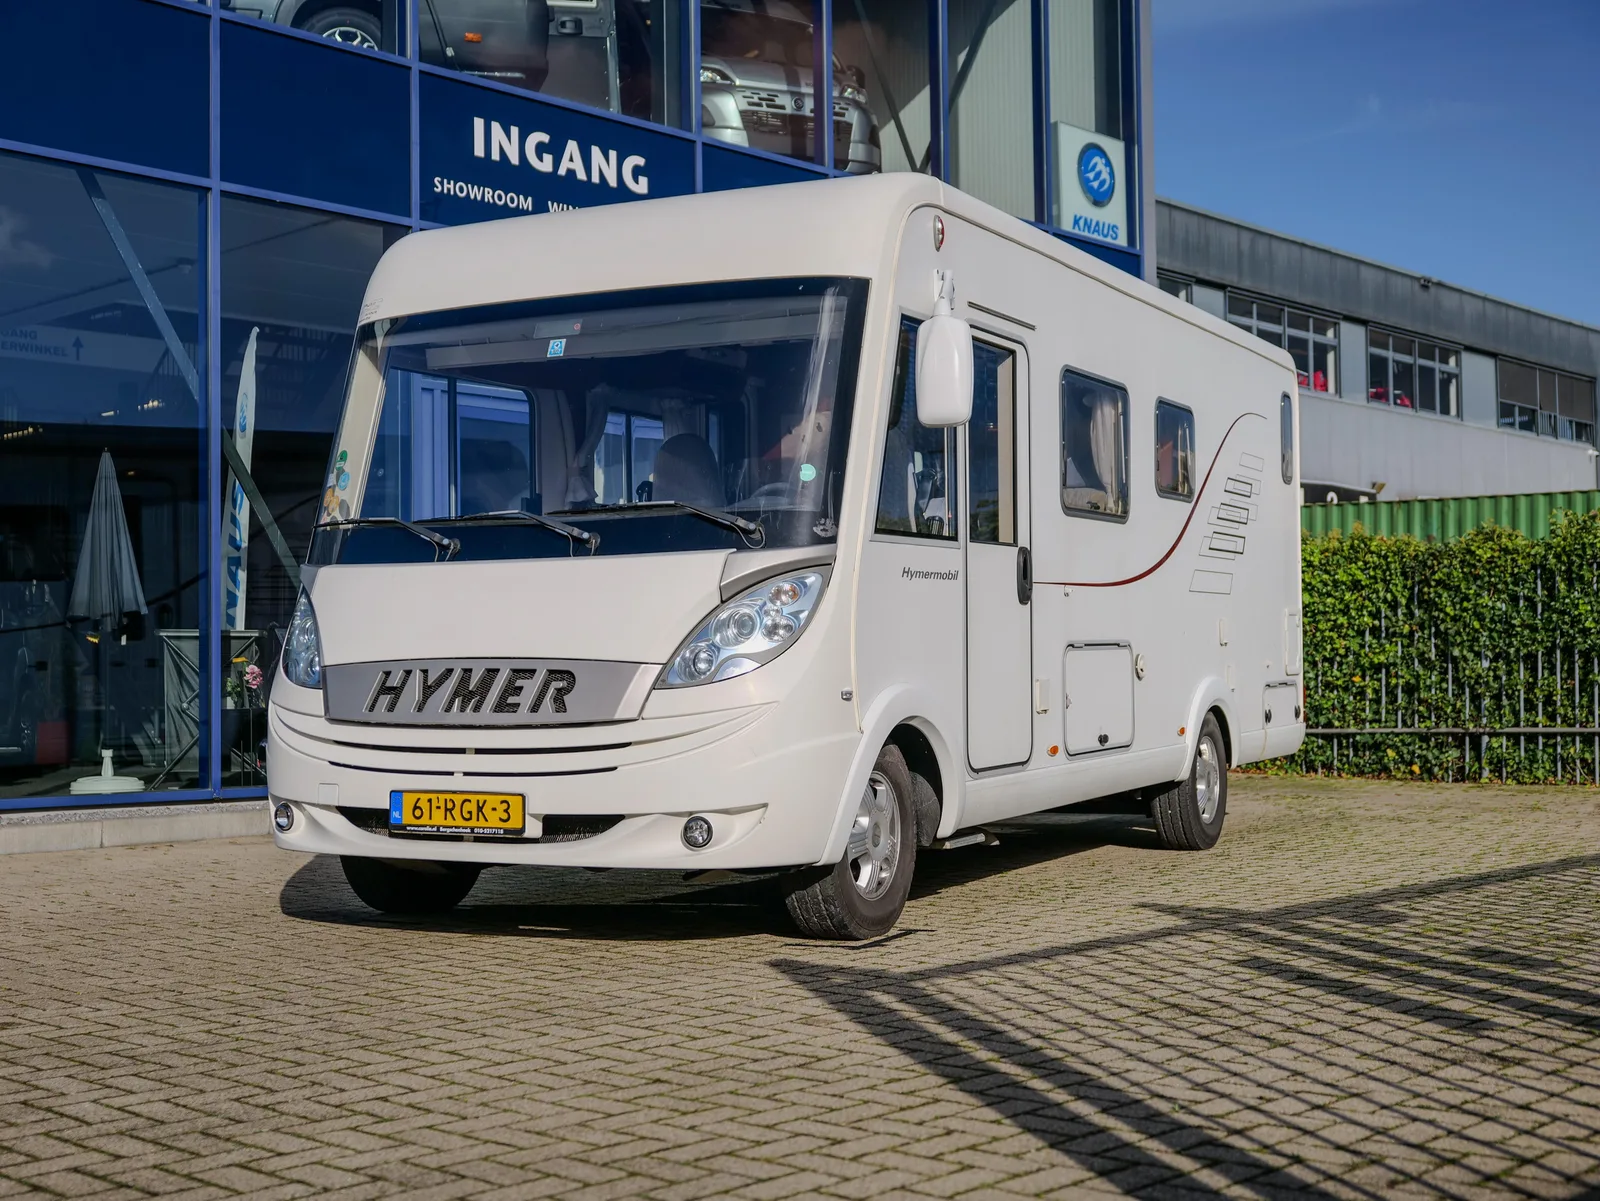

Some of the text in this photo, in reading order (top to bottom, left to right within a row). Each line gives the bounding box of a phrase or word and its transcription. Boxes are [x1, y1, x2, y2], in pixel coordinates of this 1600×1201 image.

[473, 116, 649, 195] INGANG
[433, 176, 533, 212] SHOWROOM
[1072, 214, 1119, 241] KNAUS
[901, 566, 960, 581] Hymermobil
[362, 667, 577, 714] HYMER
